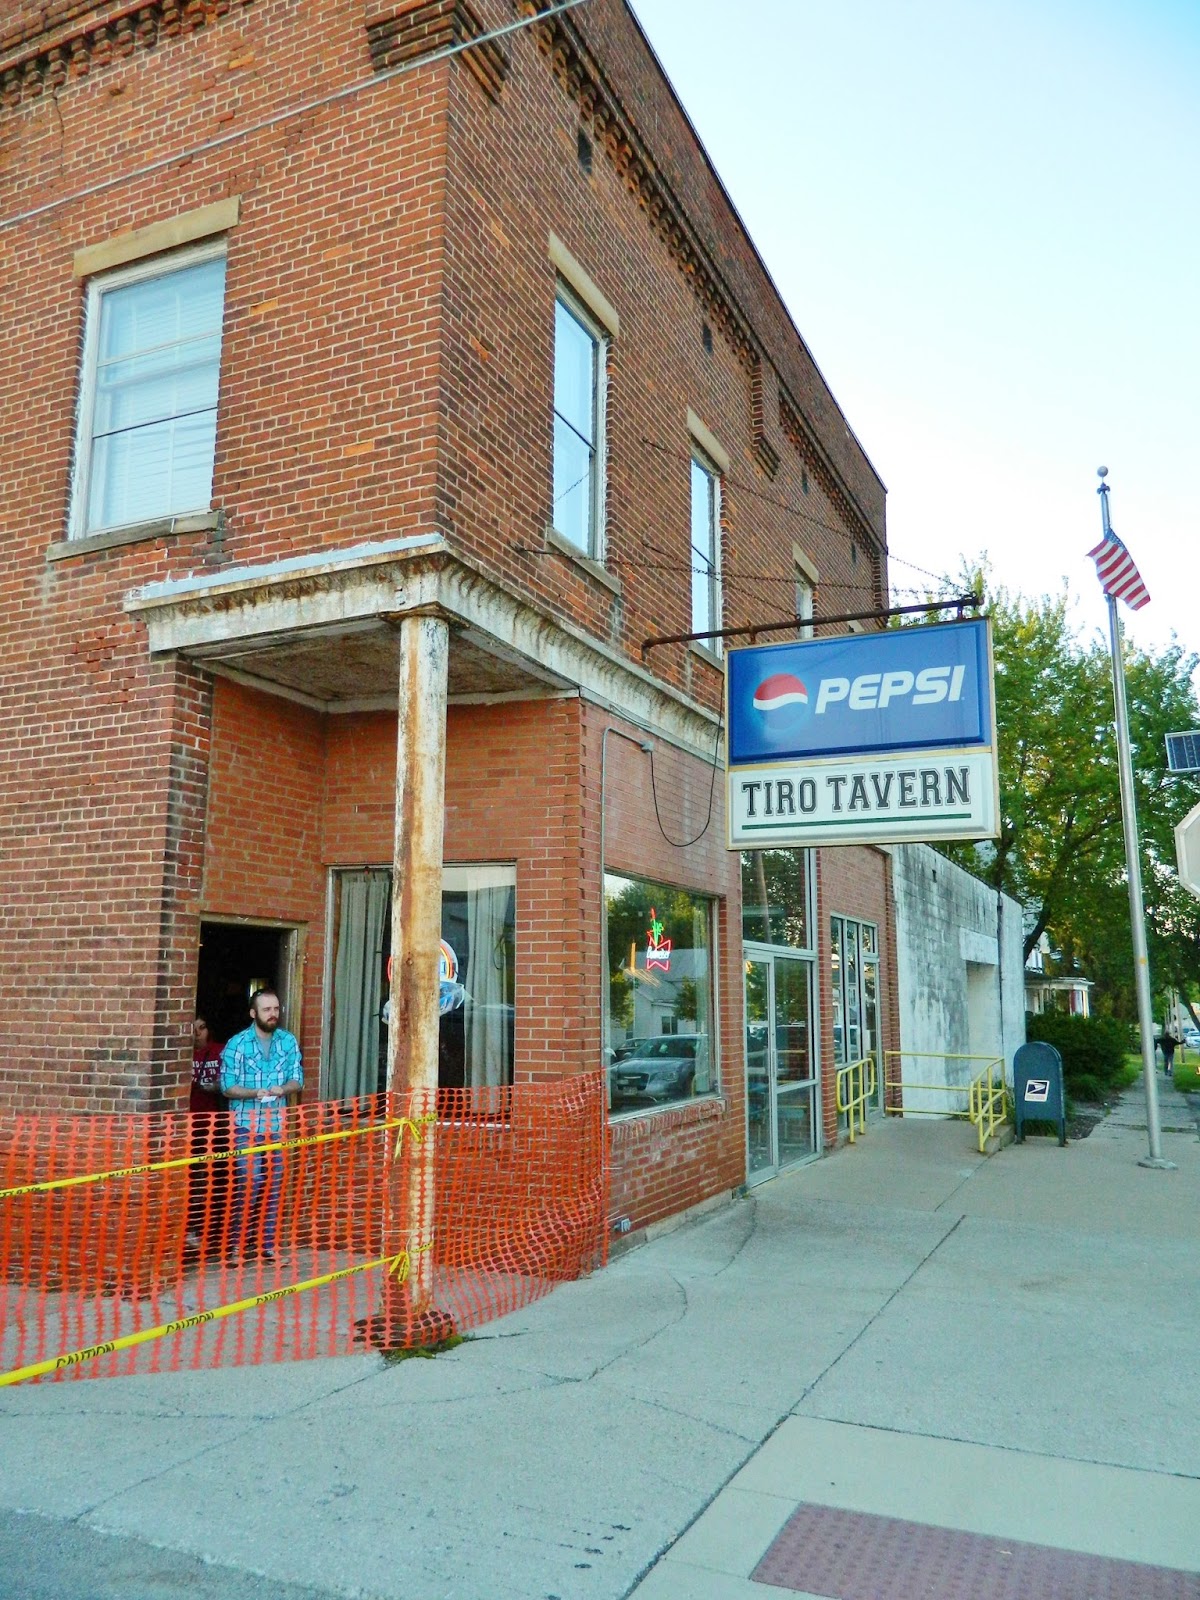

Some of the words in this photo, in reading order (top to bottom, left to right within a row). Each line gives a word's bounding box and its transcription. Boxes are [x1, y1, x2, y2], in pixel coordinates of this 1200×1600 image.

[815, 665, 965, 714] PEPSI
[741, 775, 818, 818] TIRO
[826, 766, 971, 813] TAVERN
[165, 1311, 215, 1335] CAUTION
[55, 1342, 116, 1369] CAUTION
